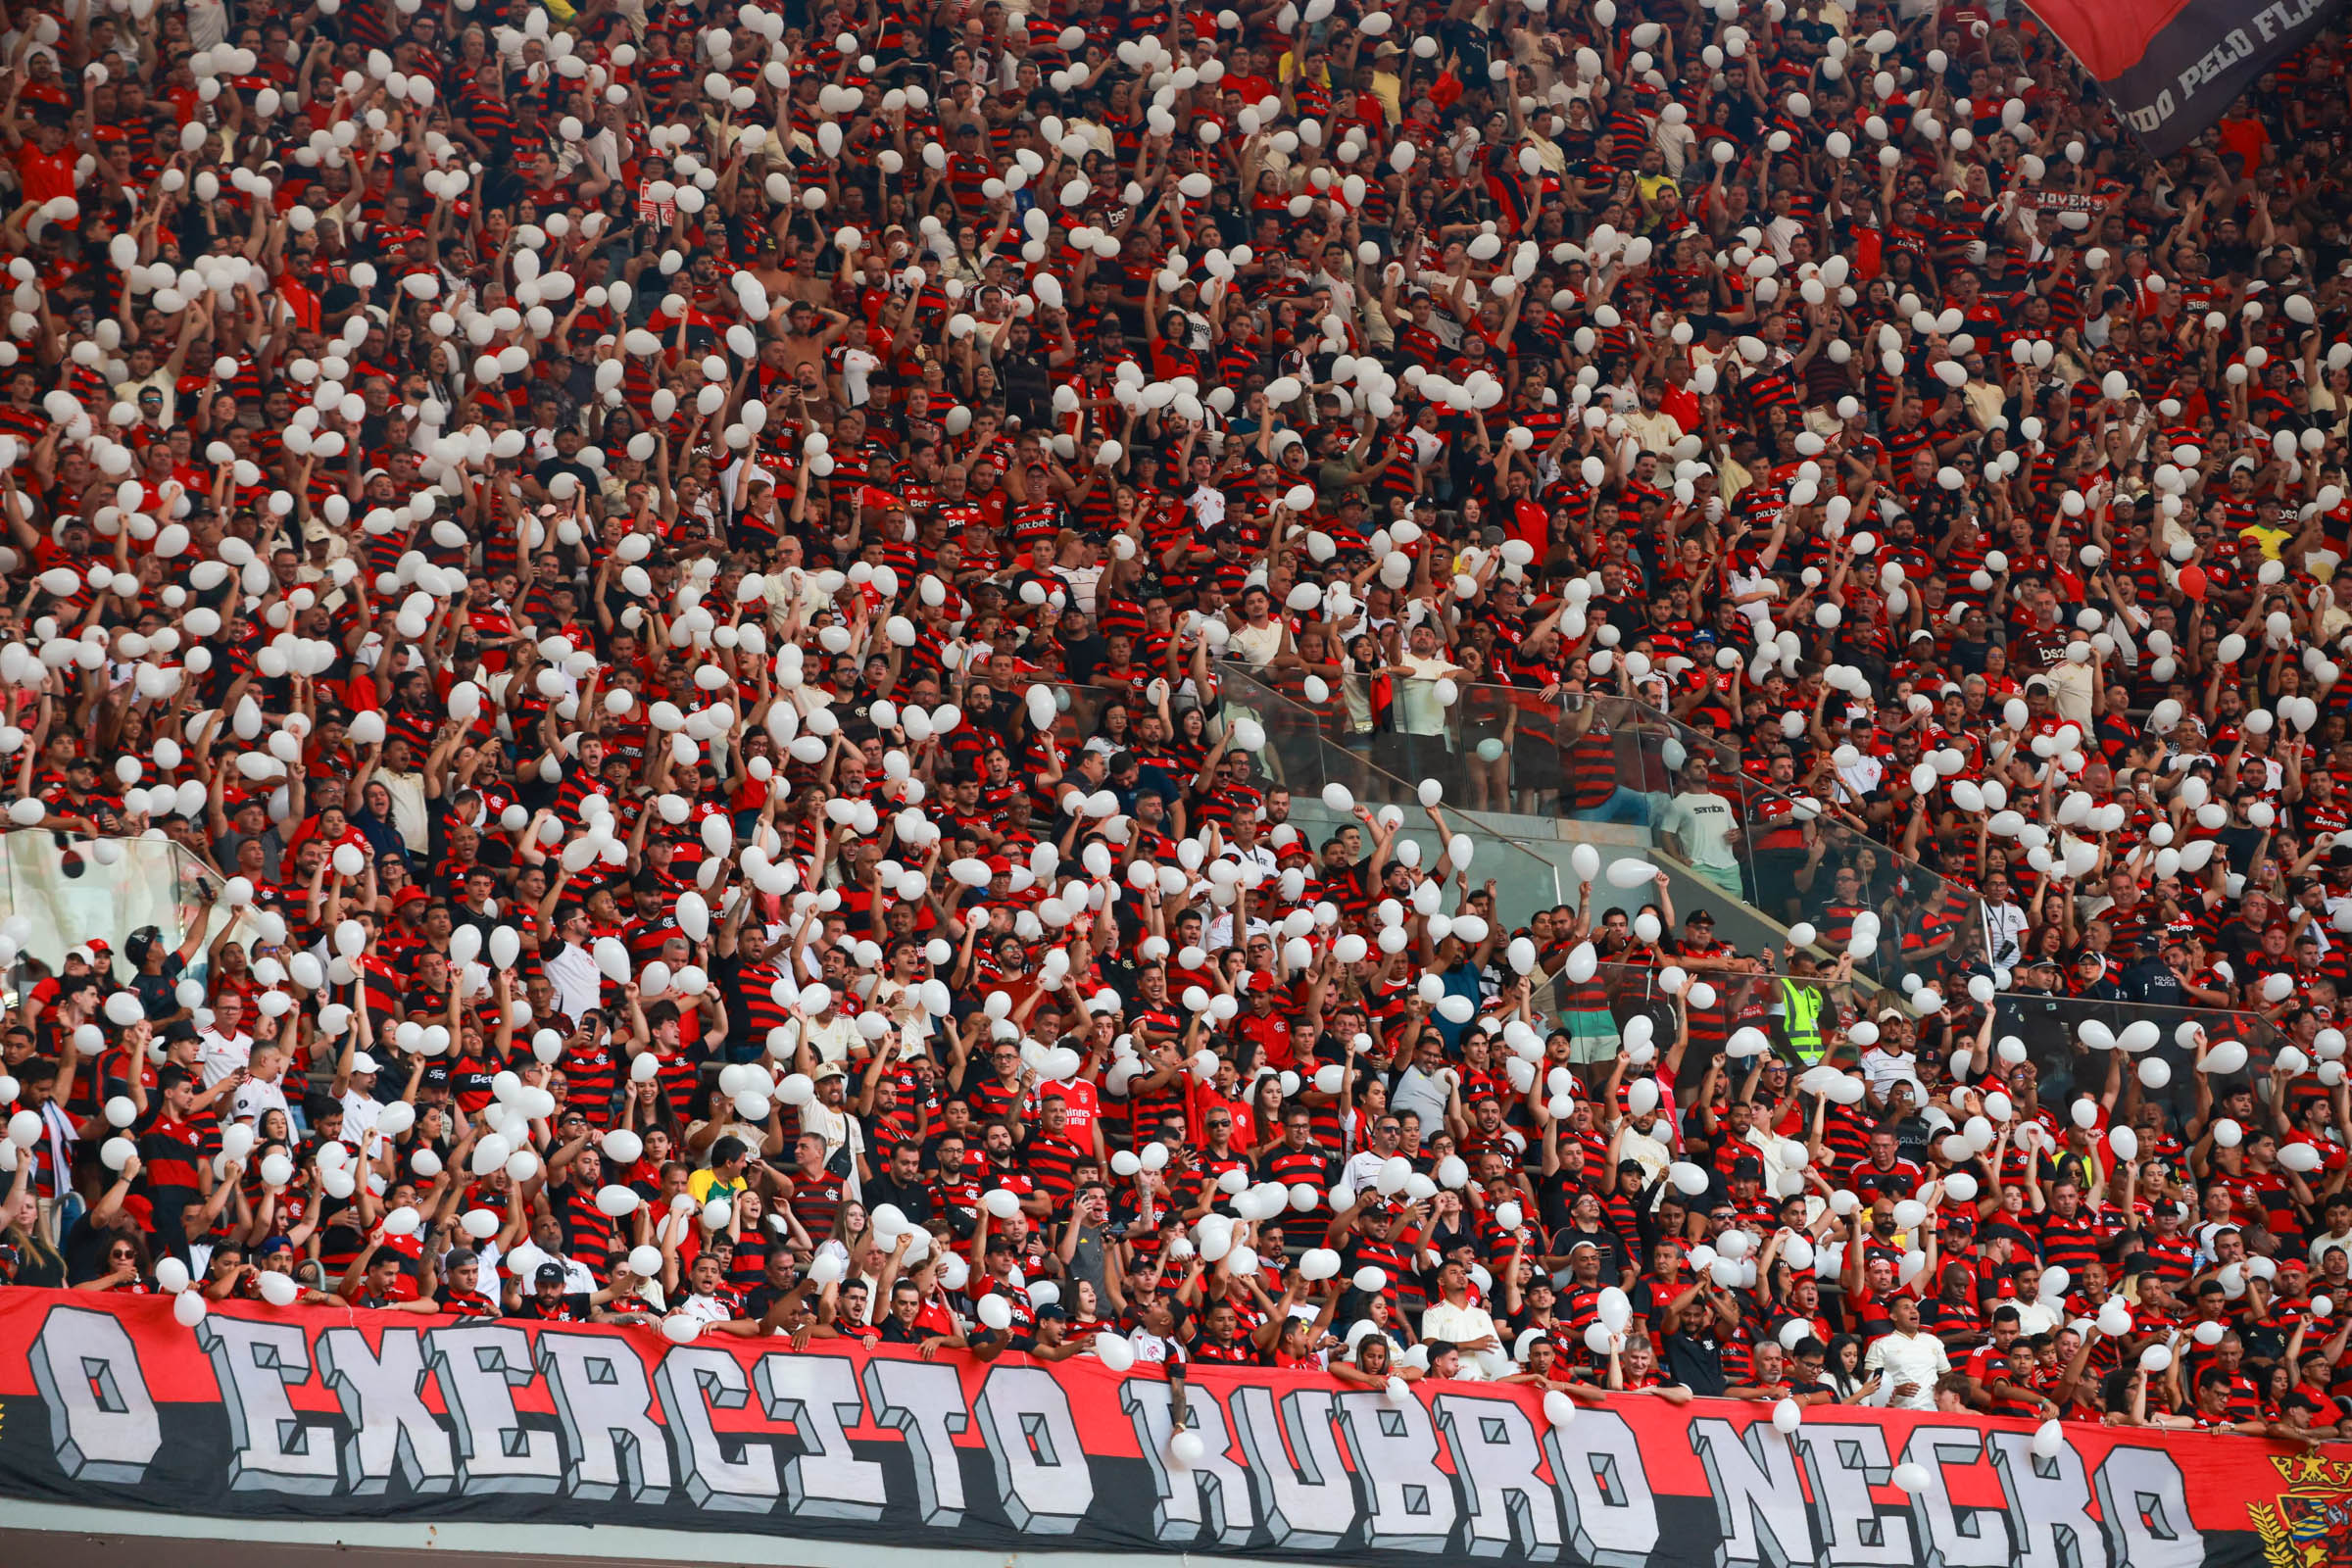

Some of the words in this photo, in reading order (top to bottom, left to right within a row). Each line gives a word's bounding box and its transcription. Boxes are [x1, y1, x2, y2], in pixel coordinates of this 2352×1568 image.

[2178, 27, 2255, 100] PELO
[2036, 192, 2091, 207] JOVEM
[1016, 518, 1051, 533] pix.bet
[2039, 647, 2066, 661] bs2
[1693, 804, 1725, 815] samba
[26, 1303, 163, 1485] O
[1119, 1376, 1661, 1568] RUBRO
